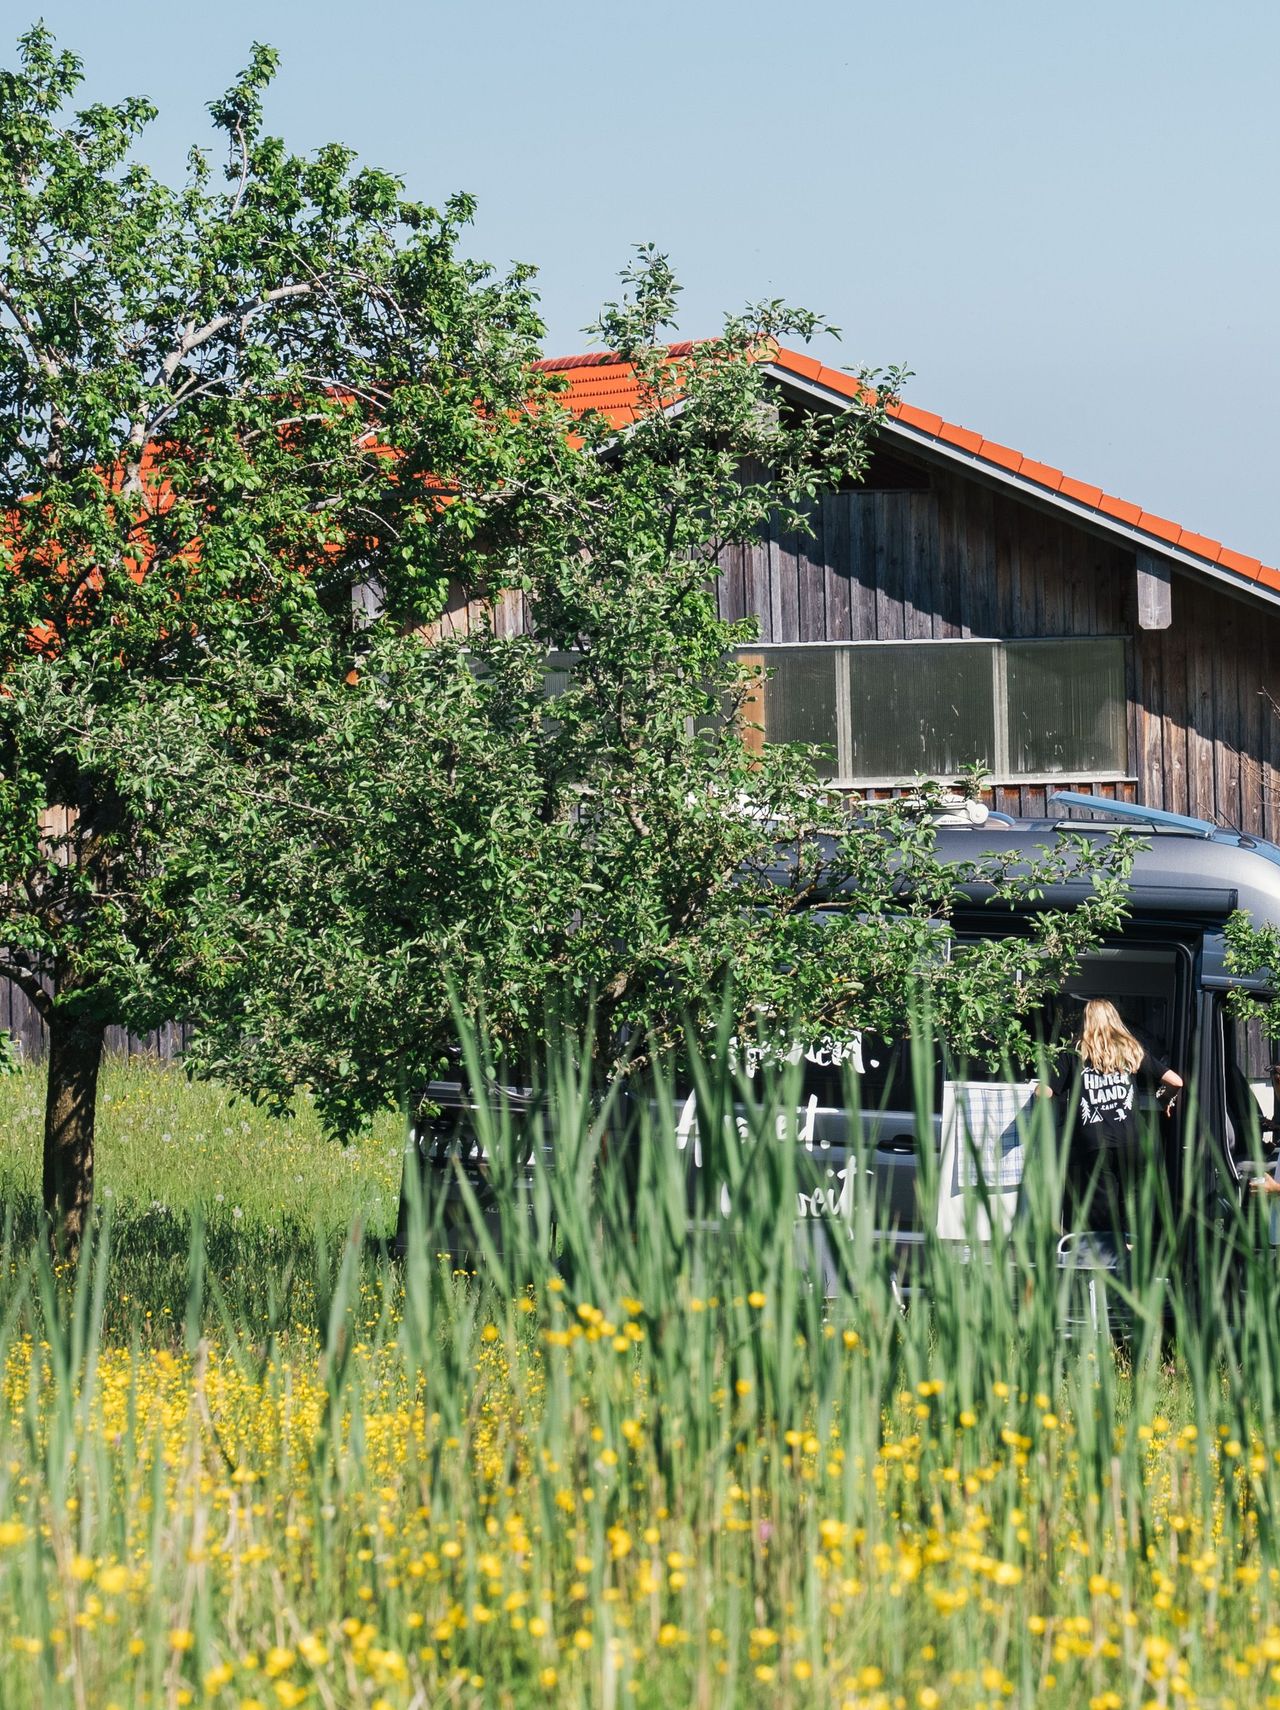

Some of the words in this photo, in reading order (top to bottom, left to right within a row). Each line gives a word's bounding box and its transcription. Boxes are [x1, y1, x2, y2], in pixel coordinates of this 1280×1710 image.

[1084, 1071, 1130, 1089] HINTER
[1089, 1085, 1127, 1104] LAND
[1100, 1102, 1117, 1110] CAMP
